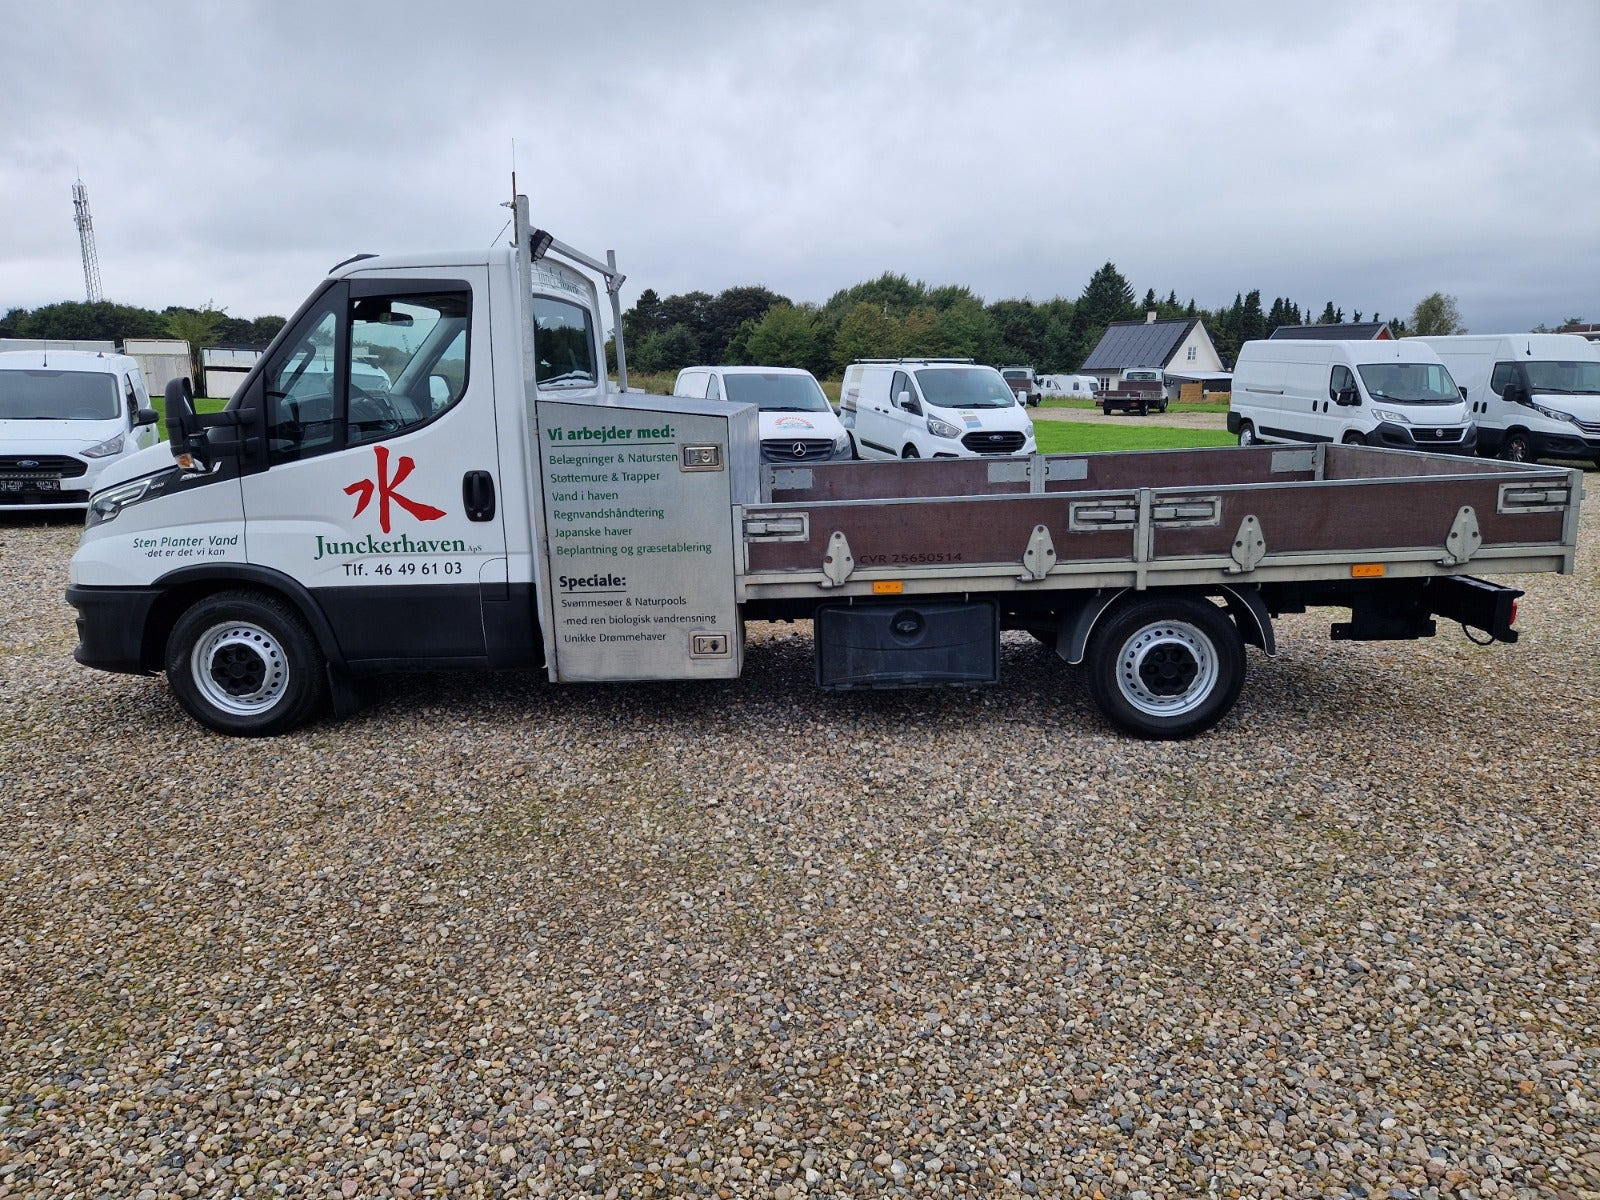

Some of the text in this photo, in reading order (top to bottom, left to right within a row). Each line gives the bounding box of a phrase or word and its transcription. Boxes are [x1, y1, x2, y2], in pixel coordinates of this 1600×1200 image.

[547, 425, 675, 443] Vi arbejder med:
[549, 453, 678, 466] Belægninger & Natursten
[551, 472, 659, 483] Støttemure & Trapper
[552, 490, 618, 501] Vand i haven
[554, 507, 664, 521] Regnvandshåndtering
[555, 527, 632, 539] Japanske haver
[133, 535, 238, 548] Sten Planter Vand
[314, 534, 466, 560] Junckerhaven
[178, 548, 192, 556] det
[197, 548, 205, 556] vi
[208, 548, 225, 556] kan
[557, 543, 711, 557] Beplantning og græsetablering
[860, 553, 962, 564] CVR 25650514
[342, 562, 462, 576] Tlf. 46 49 61 03
[560, 574, 626, 590] Speciale:
[562, 596, 686, 608] Svømmesøer & Naturpools
[591, 617, 605, 625] ren
[609, 615, 650, 625] biologisk
[654, 614, 716, 624] vandrensning
[565, 632, 666, 643] Unikke Drømmehaver
